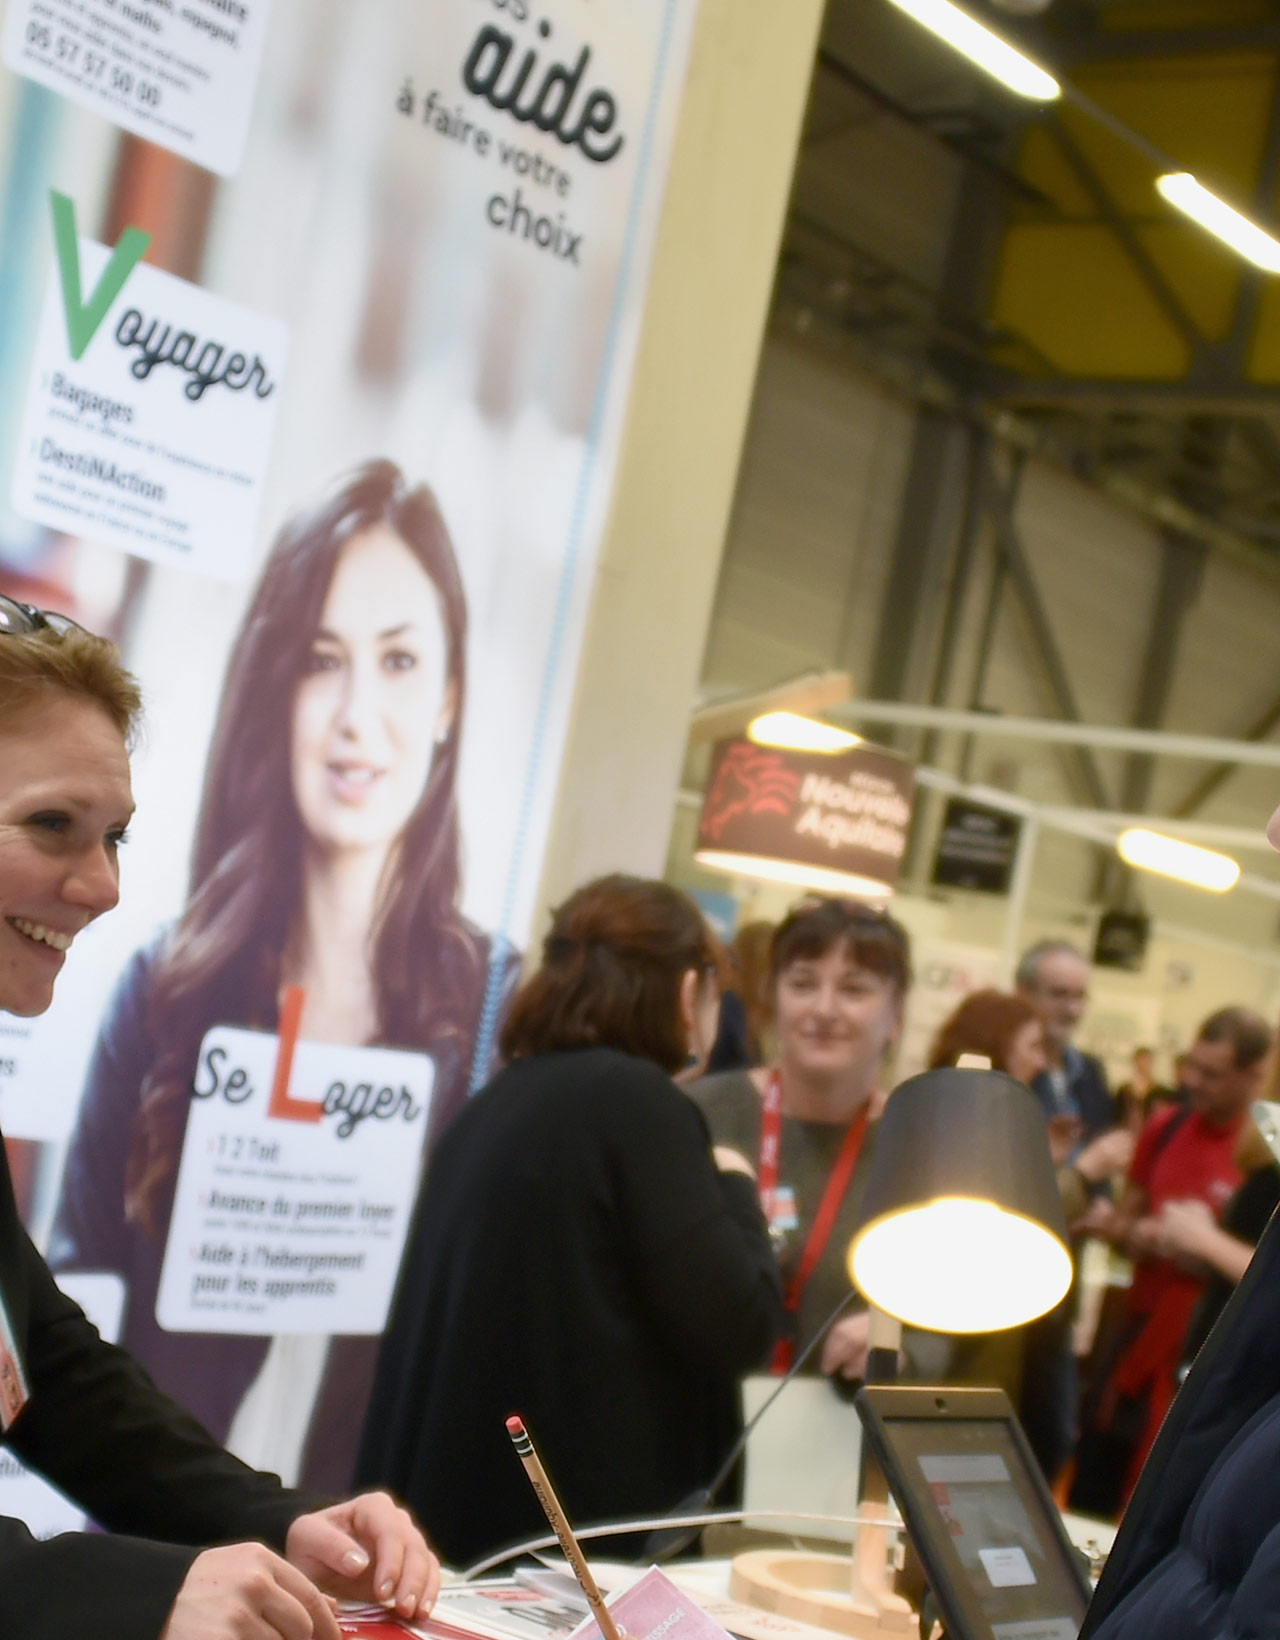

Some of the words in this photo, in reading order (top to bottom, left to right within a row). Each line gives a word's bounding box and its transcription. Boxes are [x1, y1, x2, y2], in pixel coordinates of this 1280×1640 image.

[463, 19, 625, 162] aide
[396, 76, 416, 116] à
[423, 89, 491, 156] faire
[499, 140, 570, 197] votre
[486, 188, 583, 265] choix
[48, 187, 274, 401] Voyager
[51, 371, 135, 423] Bagages
[193, 1046, 254, 1104] Se
[266, 984, 422, 1140] Loger
[208, 1189, 266, 1213] Avance
[274, 1192, 289, 1218] du
[295, 1198, 353, 1221] premier
[360, 1198, 395, 1223] loyer
[193, 1273, 231, 1295] pour
[237, 1273, 258, 1294] les
[264, 1276, 338, 1301] apprentis
[198, 1243, 234, 1264] Aide
